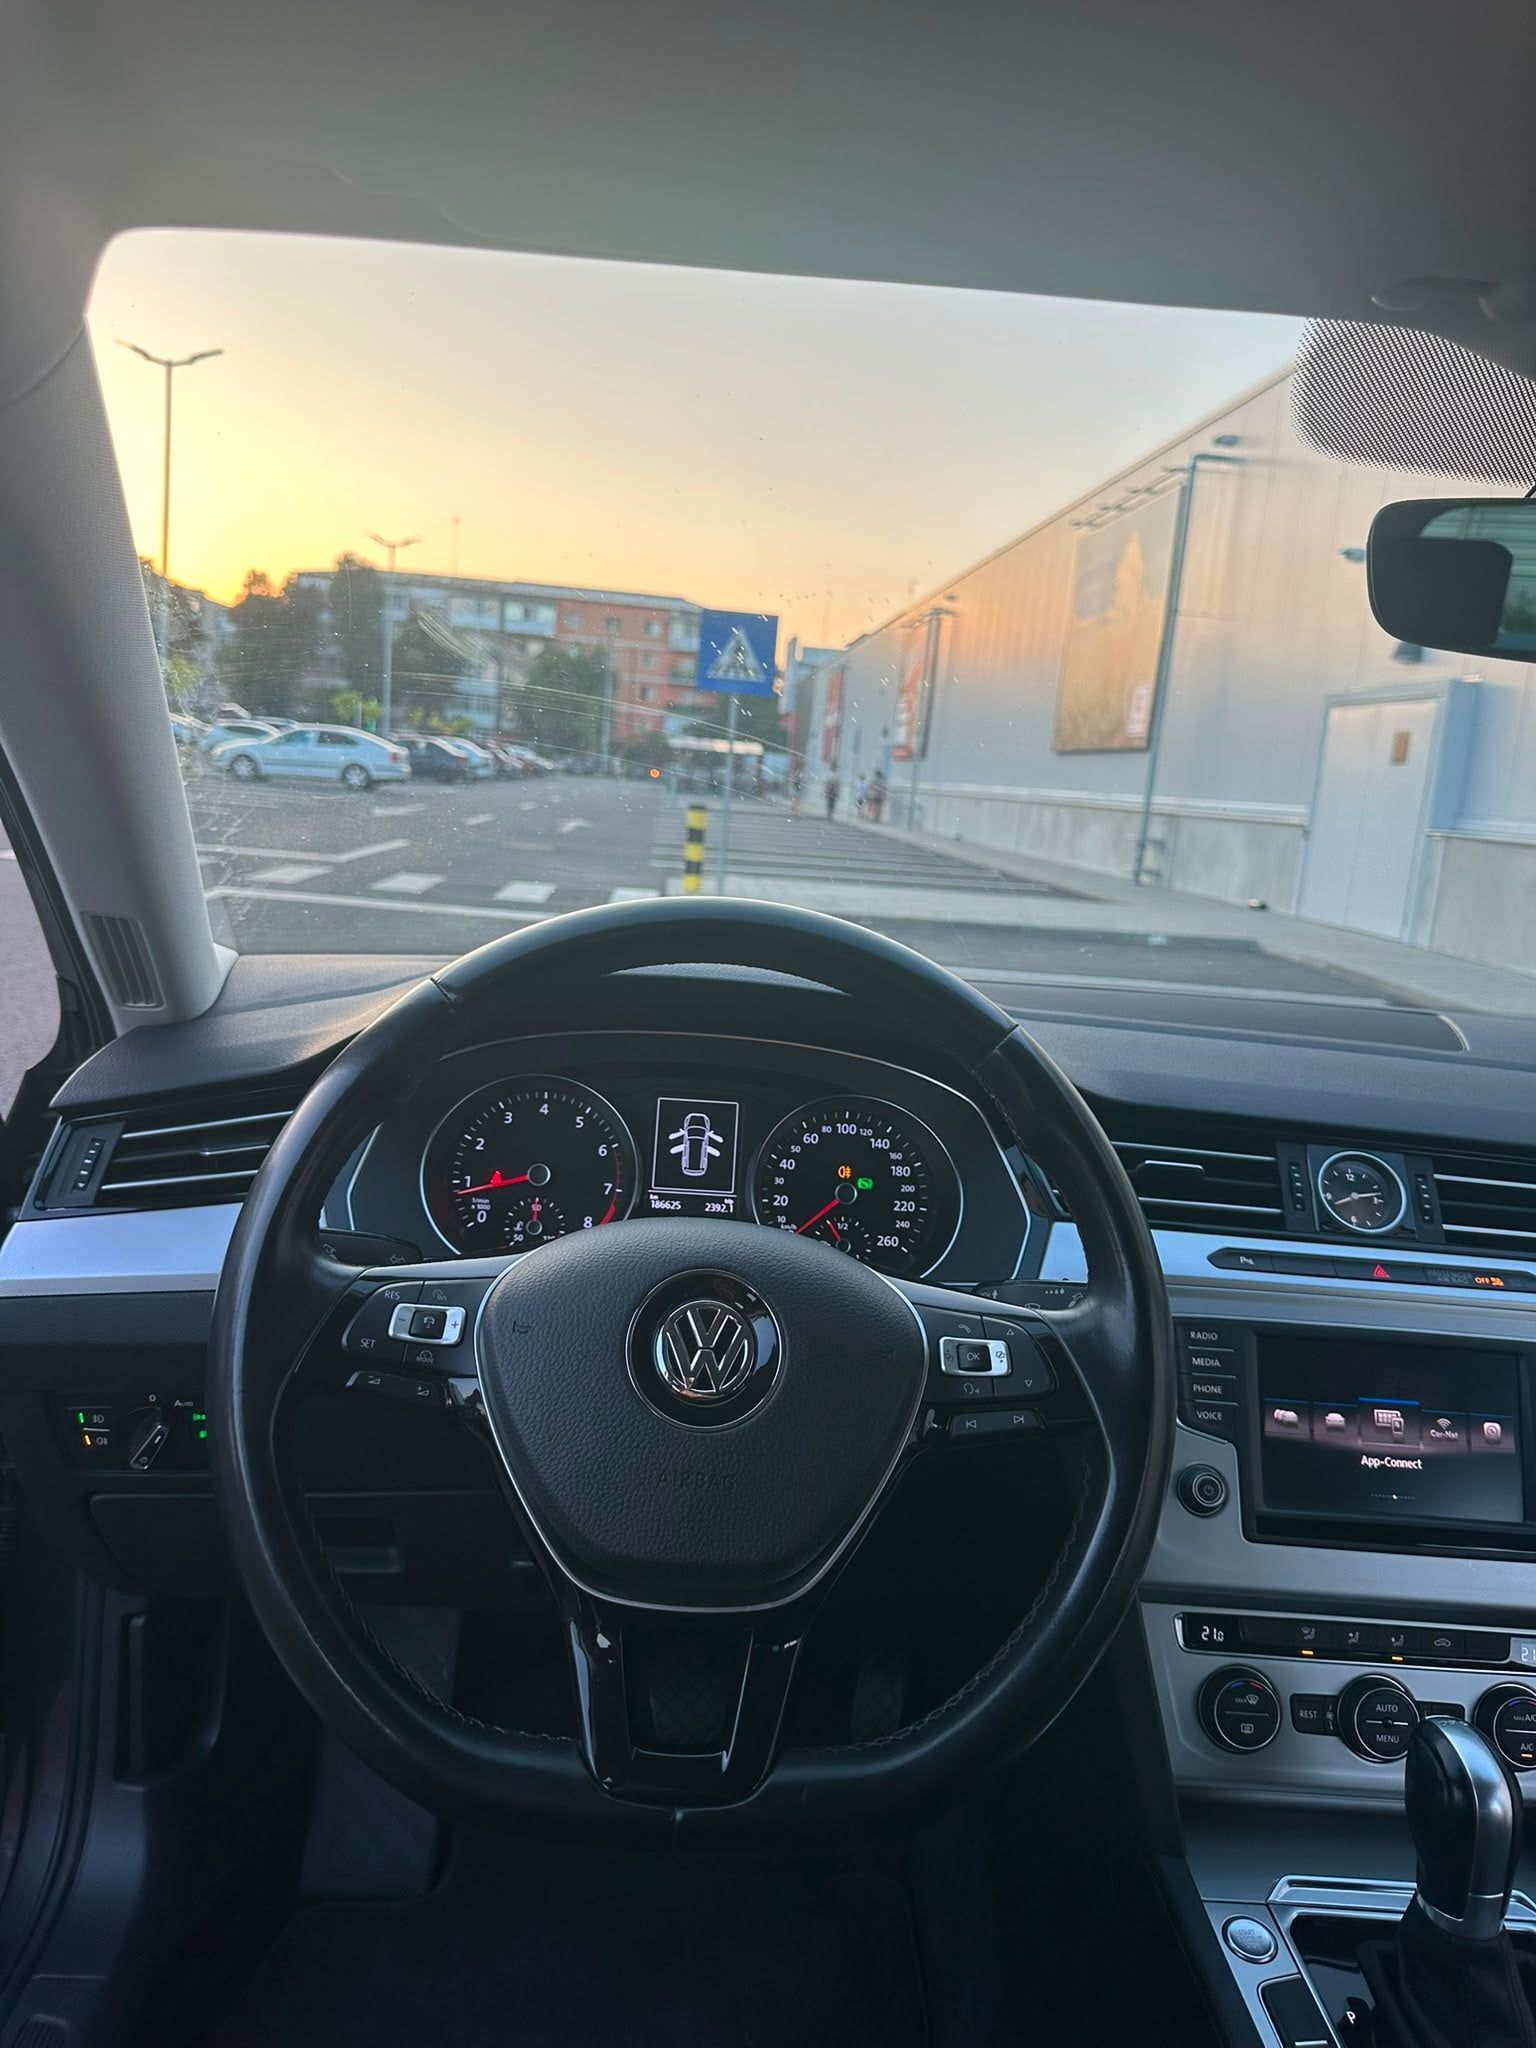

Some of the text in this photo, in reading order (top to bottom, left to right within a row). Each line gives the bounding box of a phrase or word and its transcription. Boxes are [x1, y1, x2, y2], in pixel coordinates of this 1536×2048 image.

[540, 1103, 549, 1115] 4
[504, 1112, 513, 1124] 3
[575, 1116, 584, 1128] 5
[821, 1125, 832, 1133] 80
[836, 1123, 857, 1135] 100
[859, 1128, 873, 1136] 120
[803, 1133, 819, 1144] 60
[870, 1138, 890, 1149] 140
[475, 1138, 485, 1150] 2
[790, 1145, 801, 1153] 50
[598, 1144, 608, 1157] 6
[889, 1152, 903, 1160] 160
[779, 1158, 795, 1170] 40
[890, 1165, 911, 1177] 180
[464, 1175, 472, 1188] 1
[774, 1177, 784, 1185] 30
[1345, 1173, 1355, 1181] 12
[603, 1183, 613, 1195] 7
[900, 1184, 915, 1193] 200
[651, 1200, 681, 1210] 186625
[773, 1195, 789, 1207] 20
[893, 1201, 915, 1212] 220
[477, 1211, 487, 1223] 0
[777, 1215, 786, 1223] 10
[583, 1216, 593, 1229] 8
[837, 1222, 848, 1231] 1/2
[895, 1220, 910, 1229] 240
[513, 1234, 524, 1242] 50
[877, 1235, 899, 1247] 260
[1475, 1277, 1490, 1285] OFF
[384, 1290, 400, 1300] RES
[1190, 1331, 1218, 1340] RADIO
[360, 1338, 376, 1348] SET
[966, 1351, 980, 1361] OK
[1192, 1357, 1221, 1367] MEDIA
[1193, 1384, 1222, 1394] PHONE
[1196, 1410, 1222, 1421] VOICE
[1361, 1455, 1423, 1470] App-Connect
[1375, 1703, 1398, 1713] AUTO
[1300, 1710, 1318, 1719] REST
[1376, 1734, 1400, 1743] MENU
[1521, 1743, 1534, 1751] A/C
[1346, 2010, 1356, 2024] P
